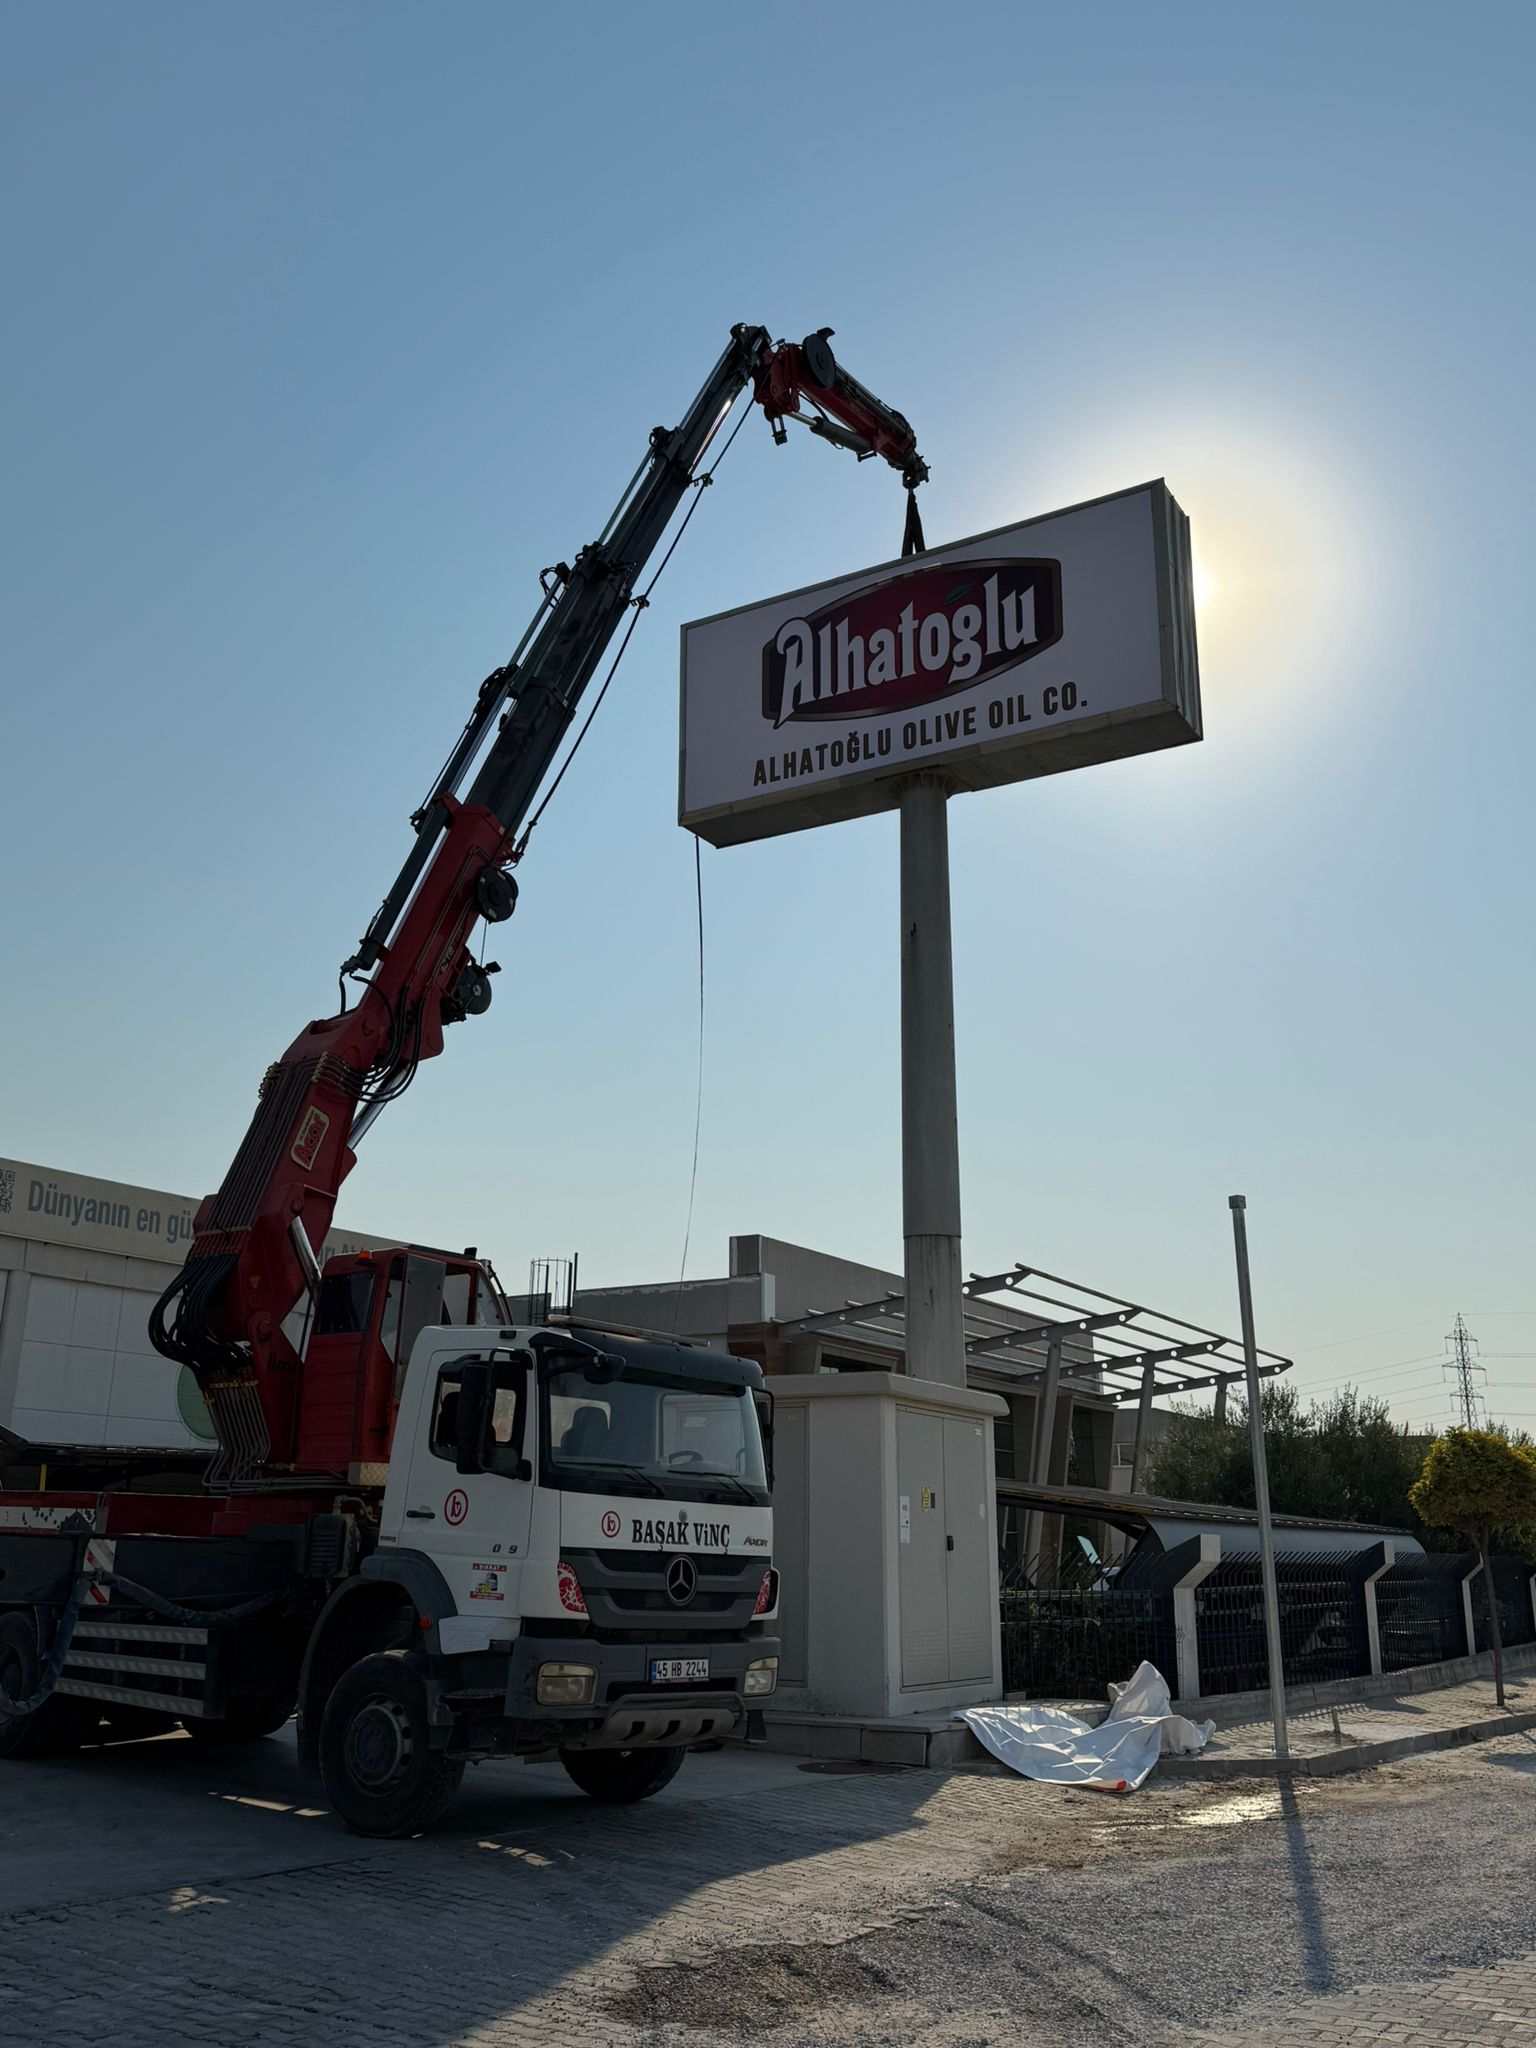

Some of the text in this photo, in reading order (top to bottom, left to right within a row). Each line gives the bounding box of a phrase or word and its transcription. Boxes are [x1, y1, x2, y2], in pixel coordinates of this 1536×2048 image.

[774, 572, 1039, 729] Alhatoglu
[753, 682, 1087, 786] ALHATOĞLU OLIVE OIL CO.
[28, 1180, 130, 1228] Dünyanın
[137, 1208, 160, 1234] en
[632, 1520, 689, 1552] BAŞAK
[657, 1661, 706, 1677] 45 HB 2244
